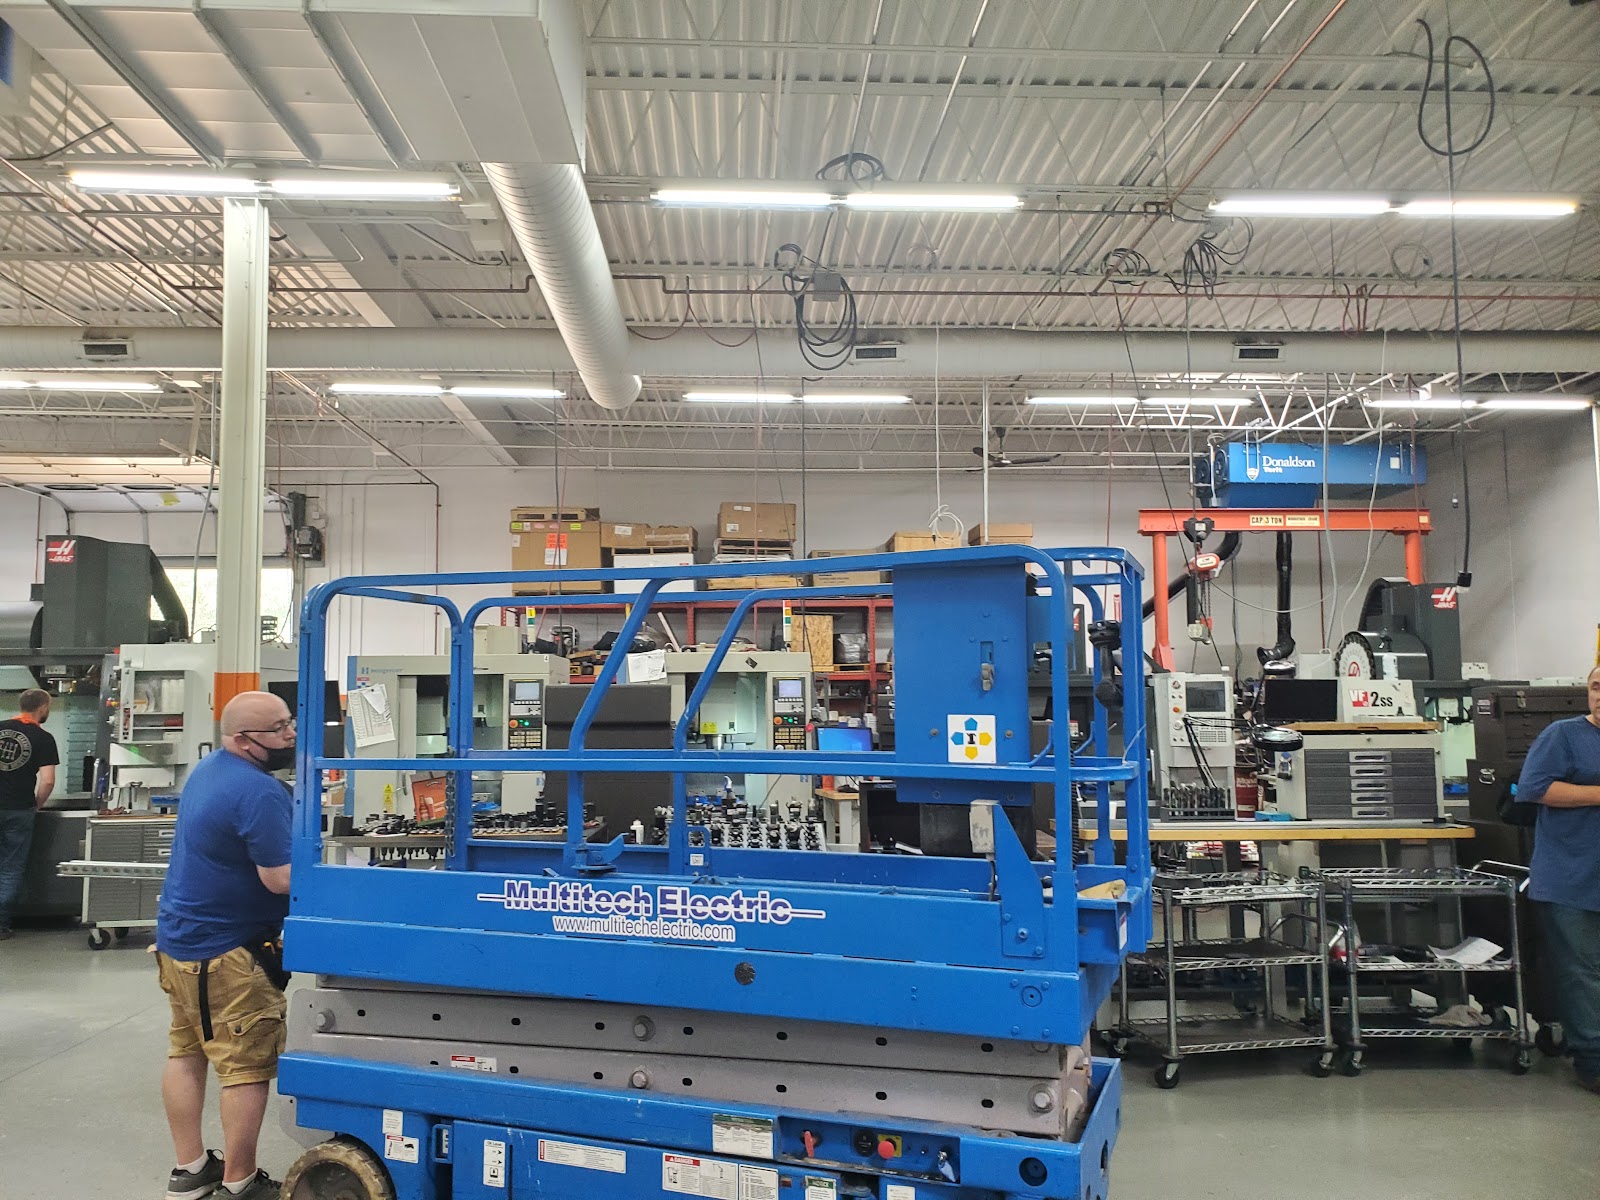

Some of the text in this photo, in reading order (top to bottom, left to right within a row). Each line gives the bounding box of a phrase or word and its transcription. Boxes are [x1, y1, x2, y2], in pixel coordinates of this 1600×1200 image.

[1262, 455, 1316, 467] Donaldson
[1271, 516, 1283, 525] TON
[1348, 689, 1368, 702] VF
[504, 881, 794, 924] Multitech Electric
[554, 916, 735, 941] www.multitechelectric.com
